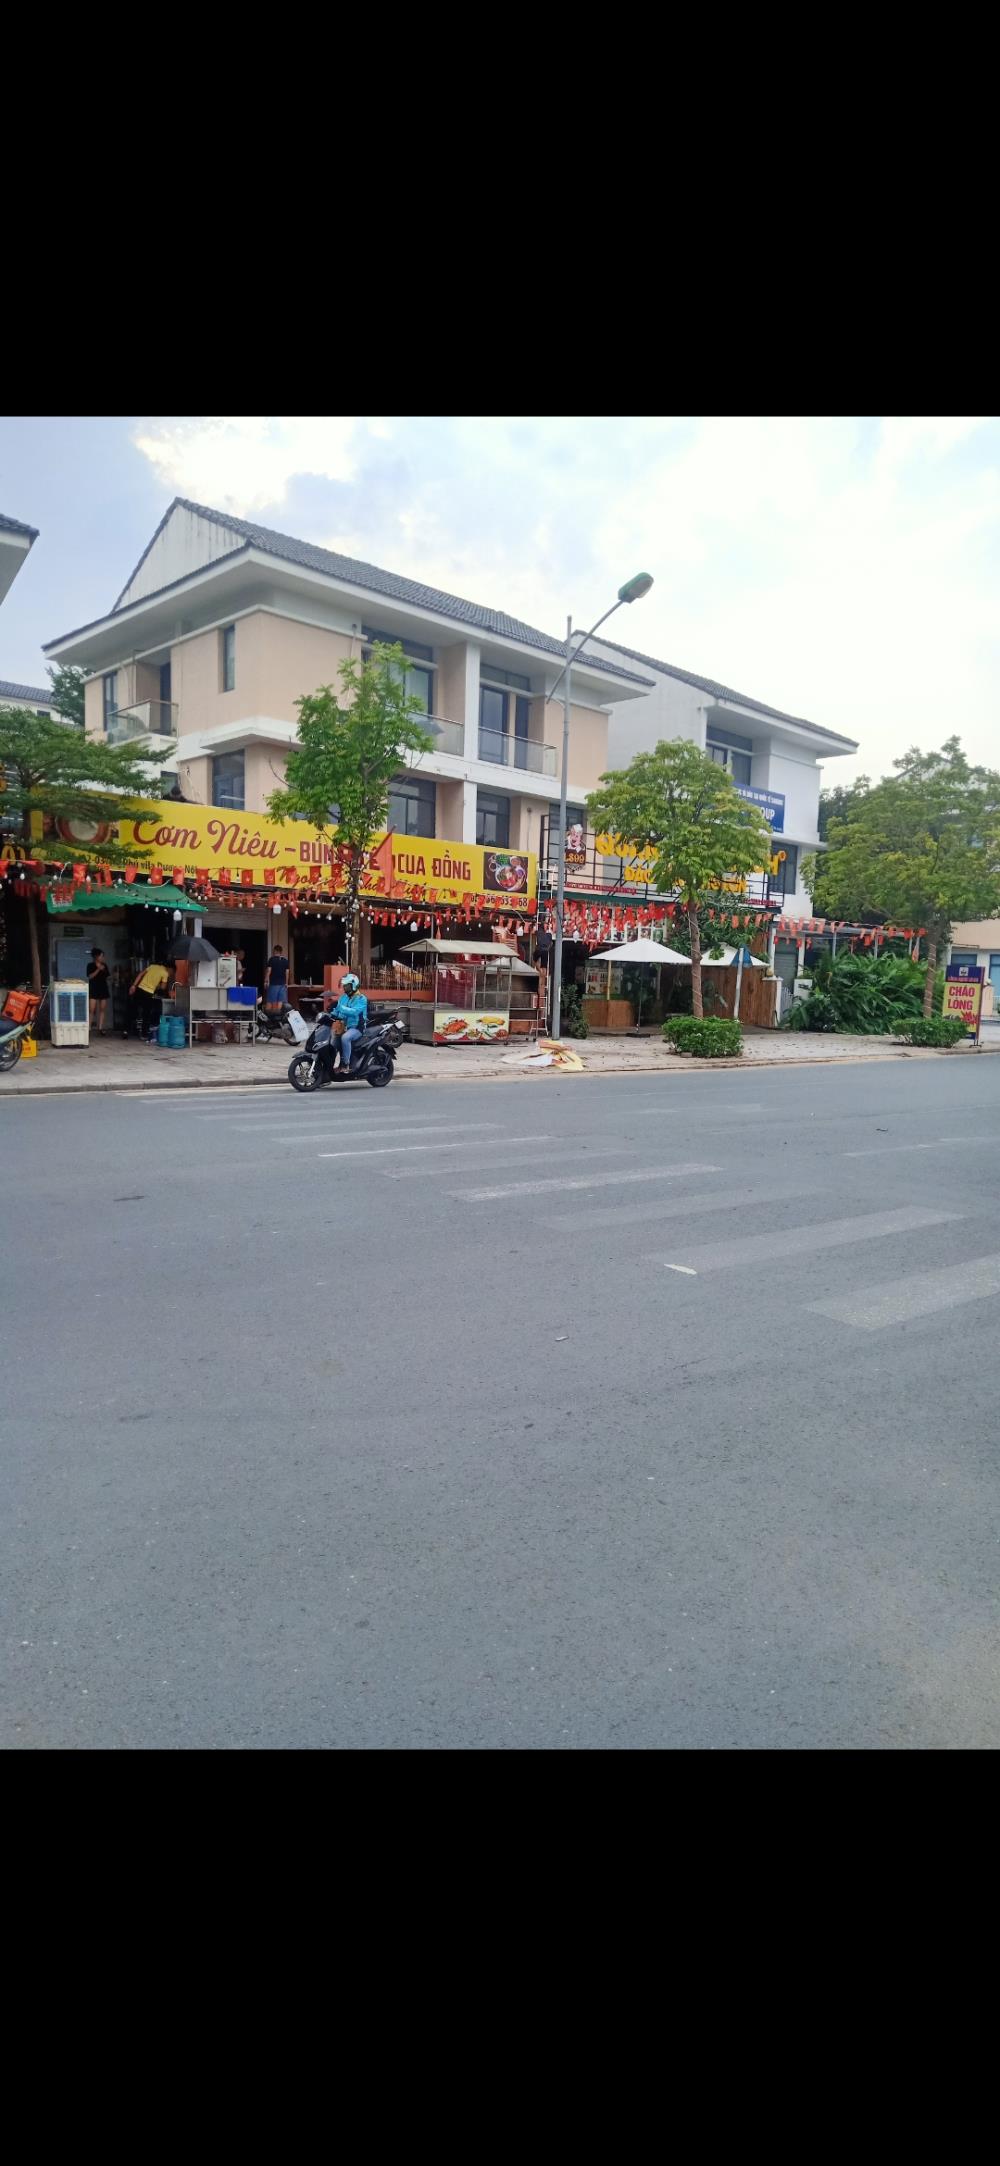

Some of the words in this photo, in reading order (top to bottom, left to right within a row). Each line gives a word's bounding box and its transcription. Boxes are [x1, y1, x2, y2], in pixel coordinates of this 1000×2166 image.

[133, 819, 202, 850] Cơm
[207, 819, 279, 859] Niêu
[397, 853, 426, 876] CUA
[431, 850, 471, 881] ĐỒNG
